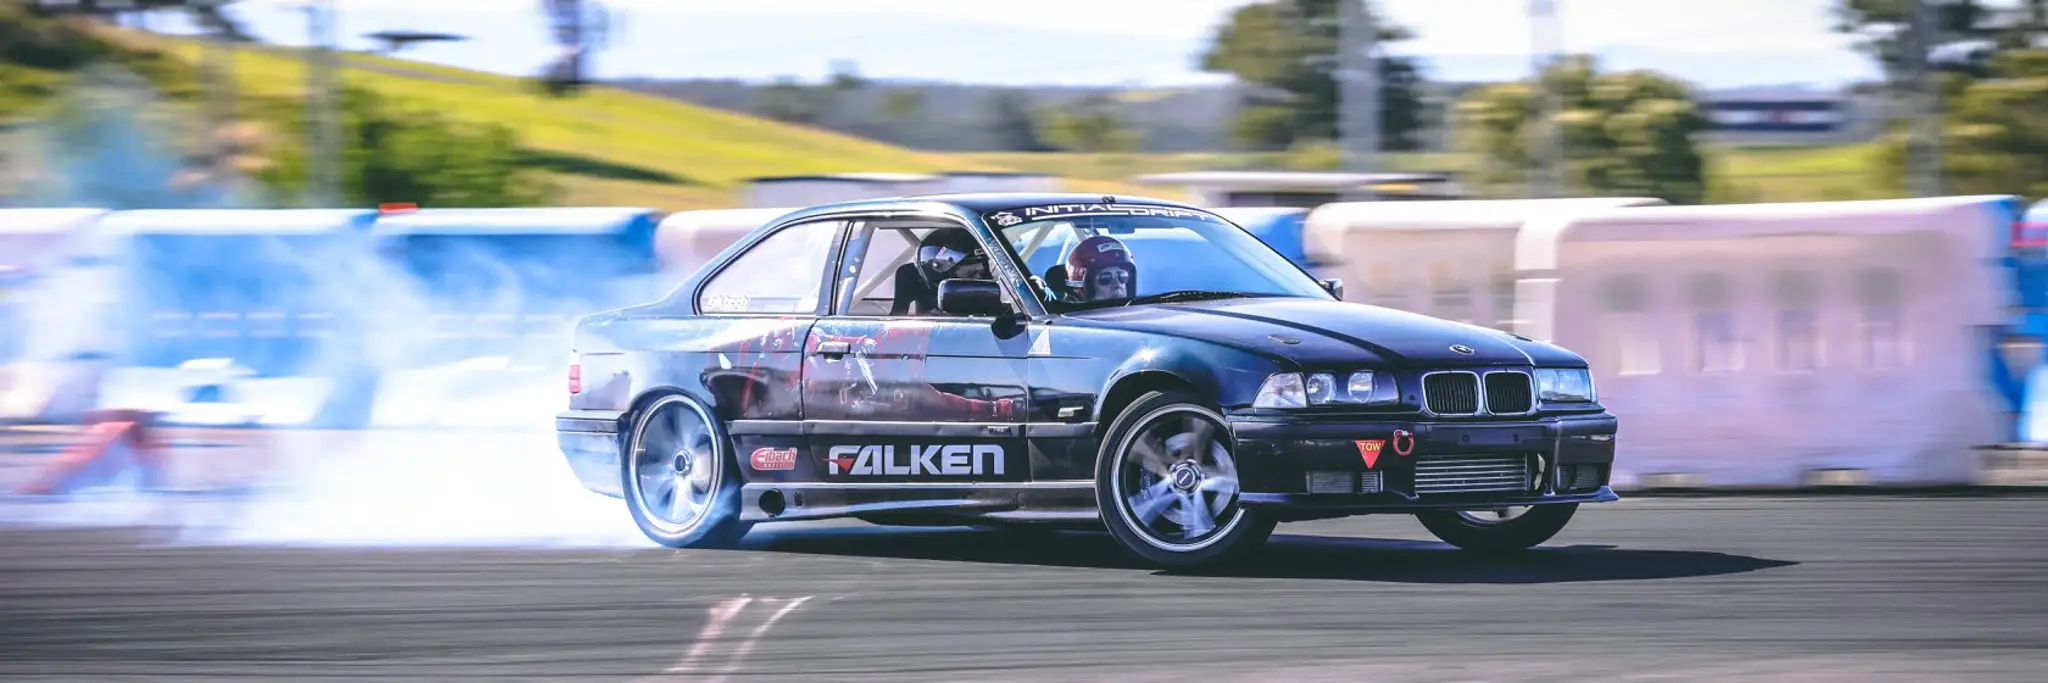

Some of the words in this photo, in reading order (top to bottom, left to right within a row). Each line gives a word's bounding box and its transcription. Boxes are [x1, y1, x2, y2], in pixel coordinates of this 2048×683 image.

[1025, 203, 1128, 216] INITIAL
[1360, 442, 1381, 451] TOW
[752, 447, 797, 463] Eibach
[828, 444, 1005, 475] FALKEN
